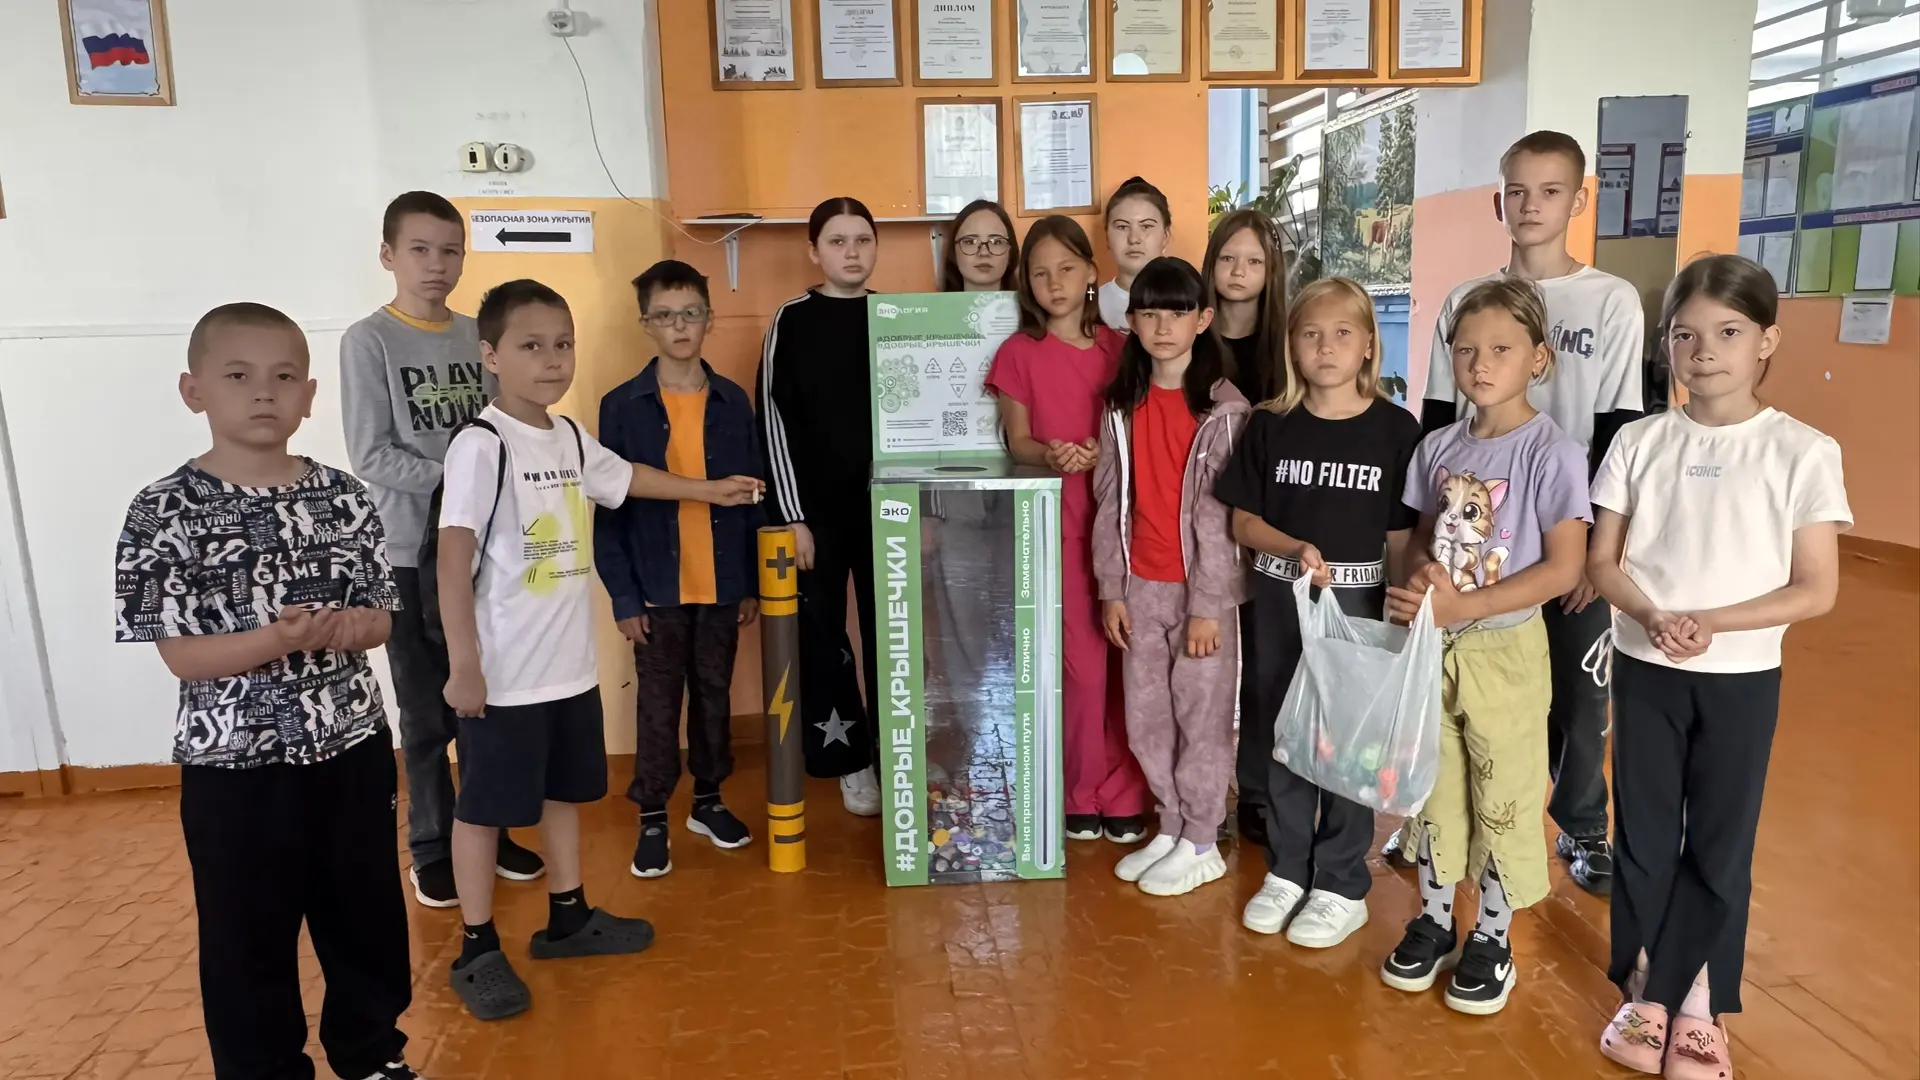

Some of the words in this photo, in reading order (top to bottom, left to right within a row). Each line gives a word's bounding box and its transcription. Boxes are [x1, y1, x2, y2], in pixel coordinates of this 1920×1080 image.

[933, 4, 975, 12] ДИПЛОМ
[471, 215, 525, 223] БЕЗОПАСНАЯ
[527, 215, 550, 223] ЗОНА
[551, 216, 591, 224] УКРЫТИЯ
[1275, 459, 1313, 486] #NO
[1318, 461, 1383, 492] FILTER
[1685, 465, 1722, 478] ICONIC
[1021, 500, 1031, 598] Замечательно
[252, 562, 321, 586] GAME
[1021, 628, 1031, 684] Отлично
[886, 536, 918, 872] #ДОБРЫЕ_КРЫШЕЧКИ
[1023, 712, 1032, 743] пути
[1023, 747, 1033, 824] правильном
[1023, 828, 1031, 842] на
[1021, 845, 1031, 862] Вы
